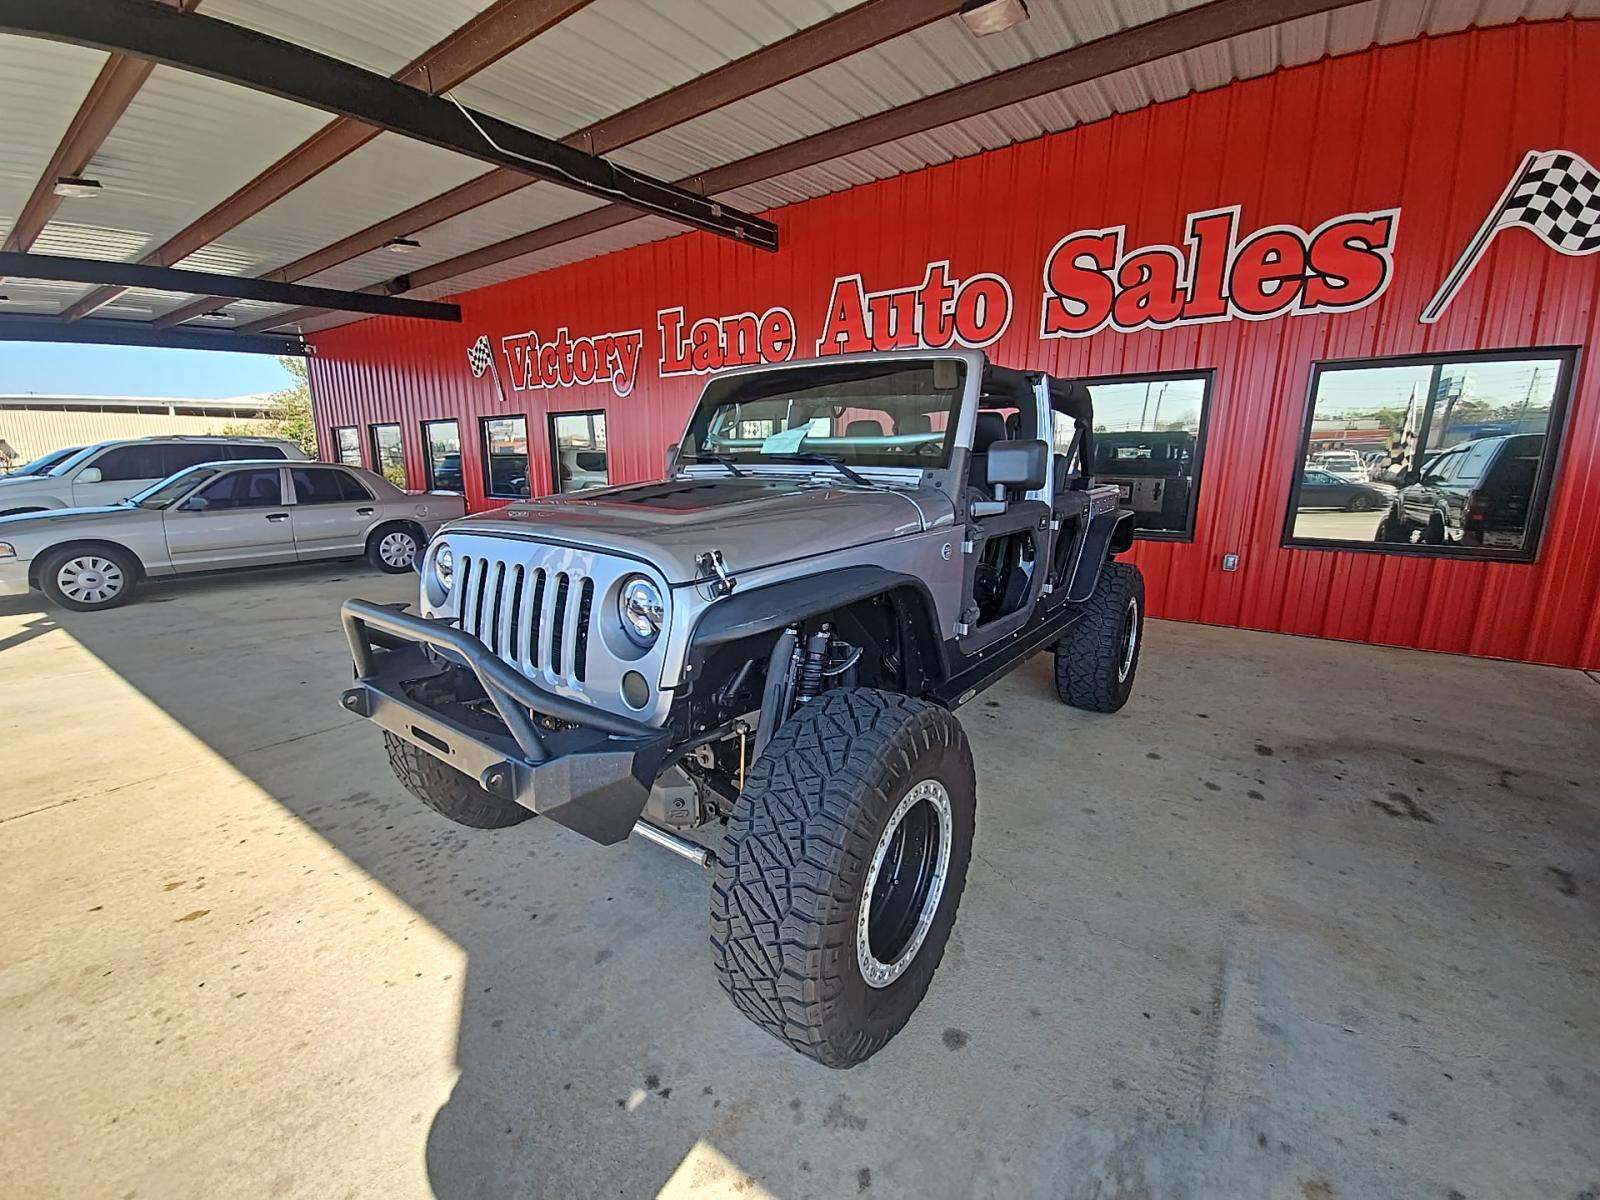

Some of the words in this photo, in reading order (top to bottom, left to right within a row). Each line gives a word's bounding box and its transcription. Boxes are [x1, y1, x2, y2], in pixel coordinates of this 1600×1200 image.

[503, 328, 642, 397] Victory
[658, 306, 796, 378] Lane
[818, 260, 1013, 357] Auto
[1039, 205, 1401, 339] Sales
